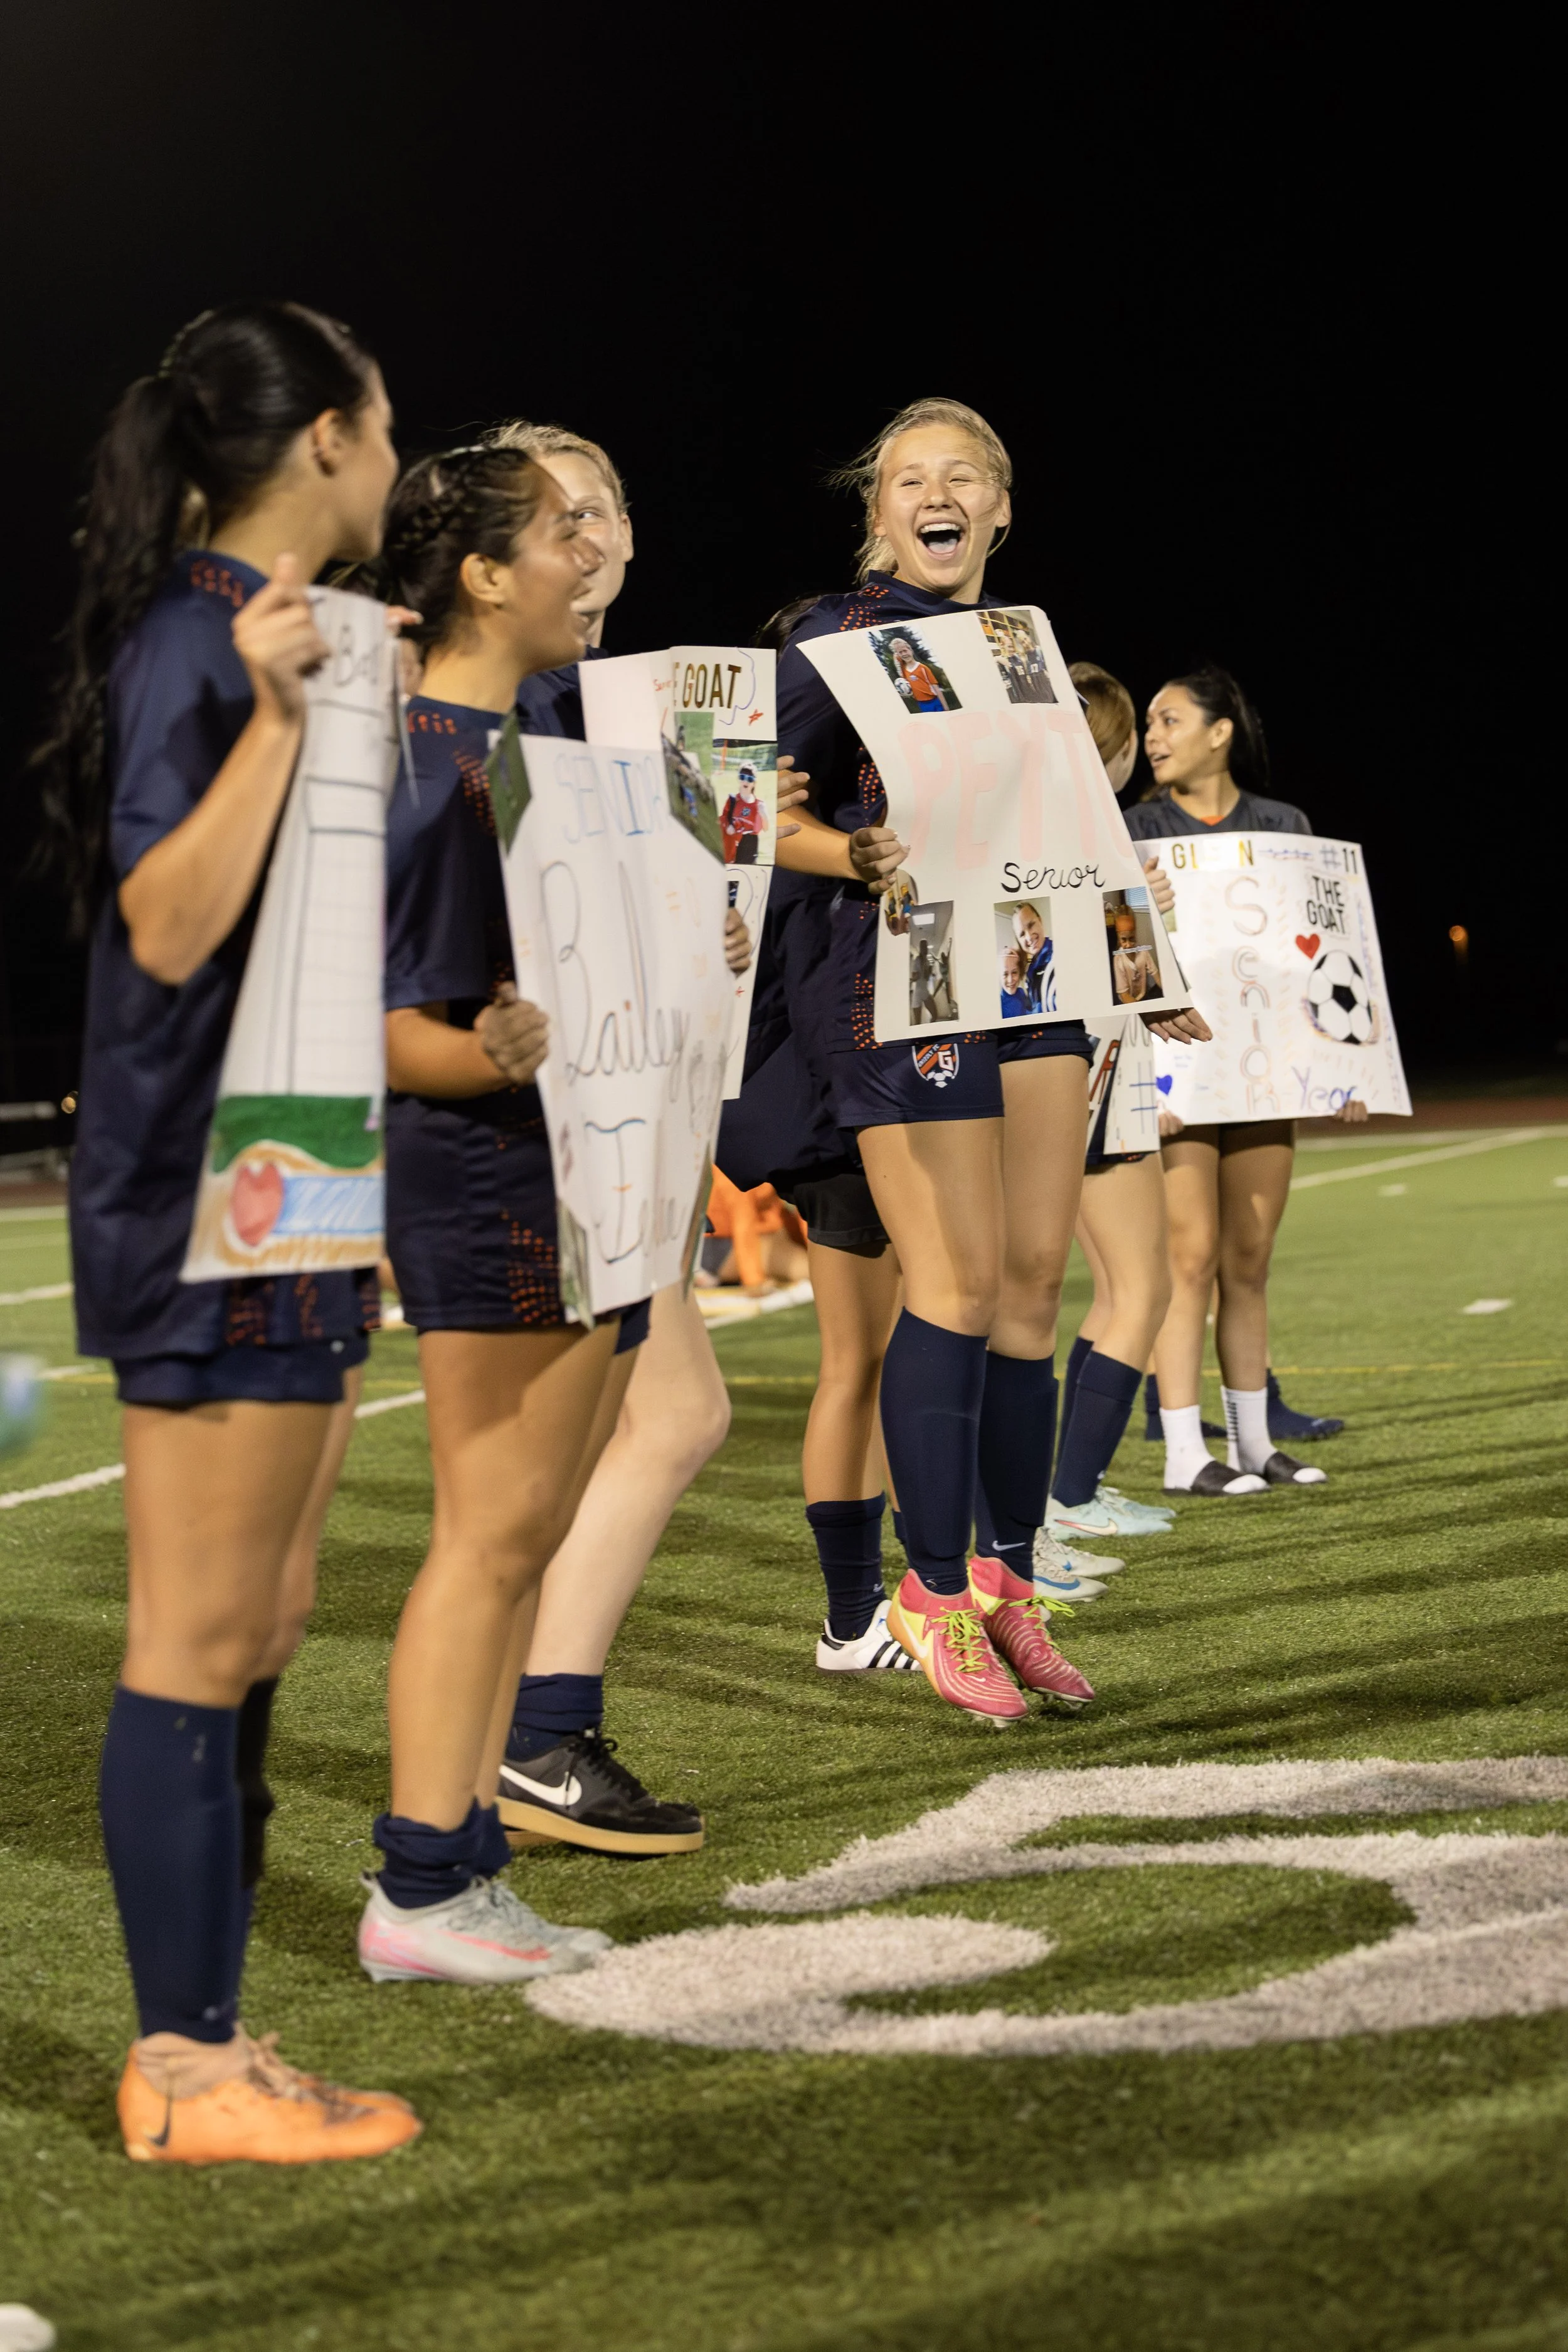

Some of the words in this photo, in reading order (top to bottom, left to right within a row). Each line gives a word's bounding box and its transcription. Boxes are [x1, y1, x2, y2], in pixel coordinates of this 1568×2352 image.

[682, 662, 742, 709] GOAT
[1172, 840, 1254, 869] GLN
[1000, 862, 1106, 893] Senior
[1311, 875, 1345, 907] THE
[1306, 900, 1347, 935] GOAT
[937, 1051, 954, 1071] G
[1291, 1065, 1358, 1111] Year
